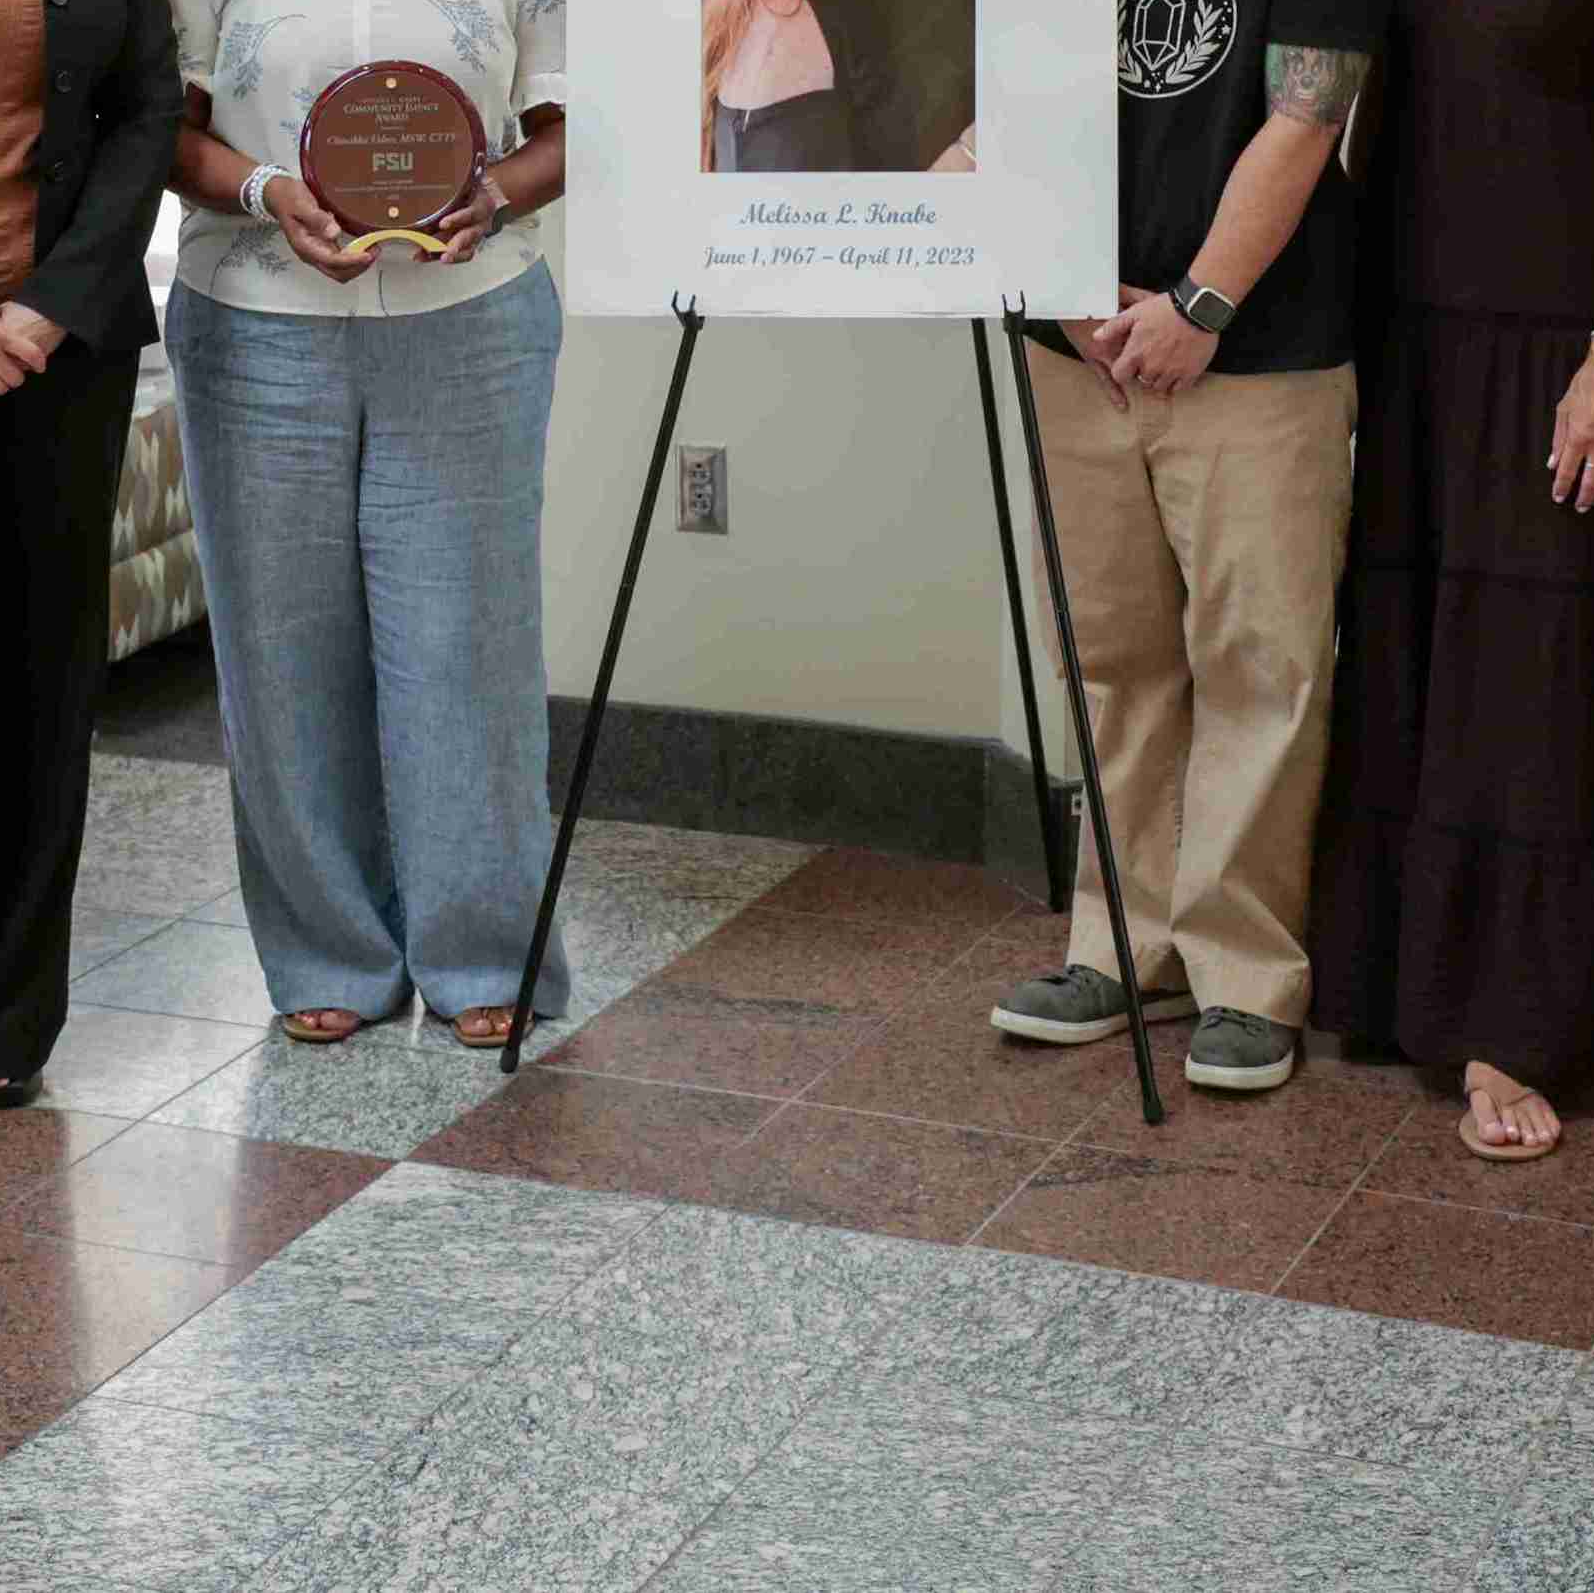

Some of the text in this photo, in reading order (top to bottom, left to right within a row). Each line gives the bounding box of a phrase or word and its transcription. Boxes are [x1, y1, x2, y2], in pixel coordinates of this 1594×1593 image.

[372, 152, 413, 172] FSU
[739, 202, 938, 225] Melissa L. Knabe
[704, 246, 746, 269] June
[771, 247, 816, 266] 1967
[839, 246, 889, 270] April
[895, 247, 921, 270] 11,
[926, 246, 975, 266] 2023
